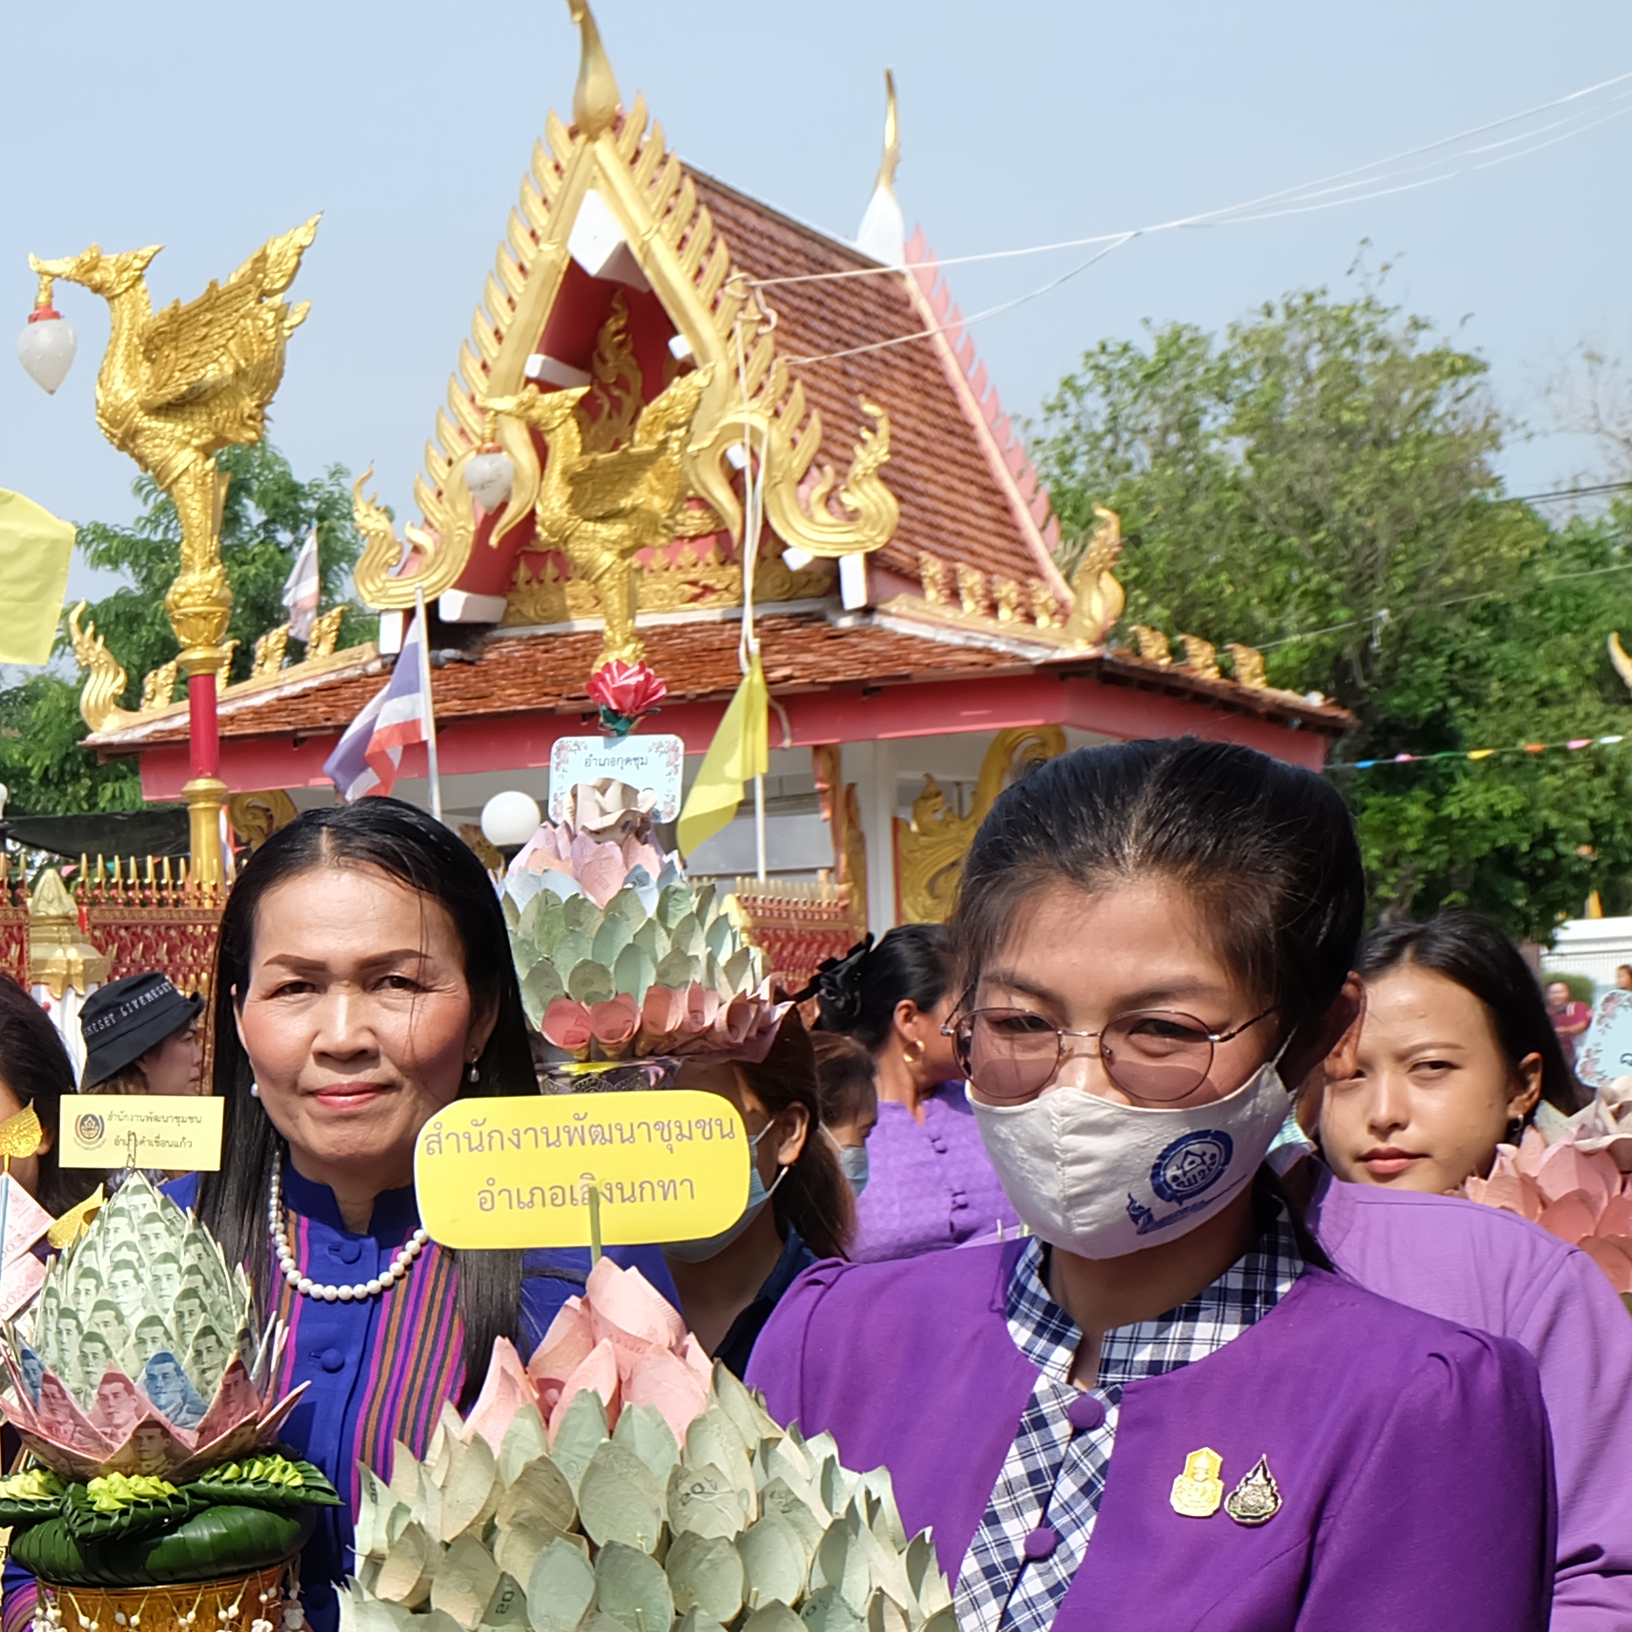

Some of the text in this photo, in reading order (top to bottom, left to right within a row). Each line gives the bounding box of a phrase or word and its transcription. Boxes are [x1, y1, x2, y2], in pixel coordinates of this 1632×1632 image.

[424, 1112, 737, 1156] สำนักงานพัฒนาชุมชน
